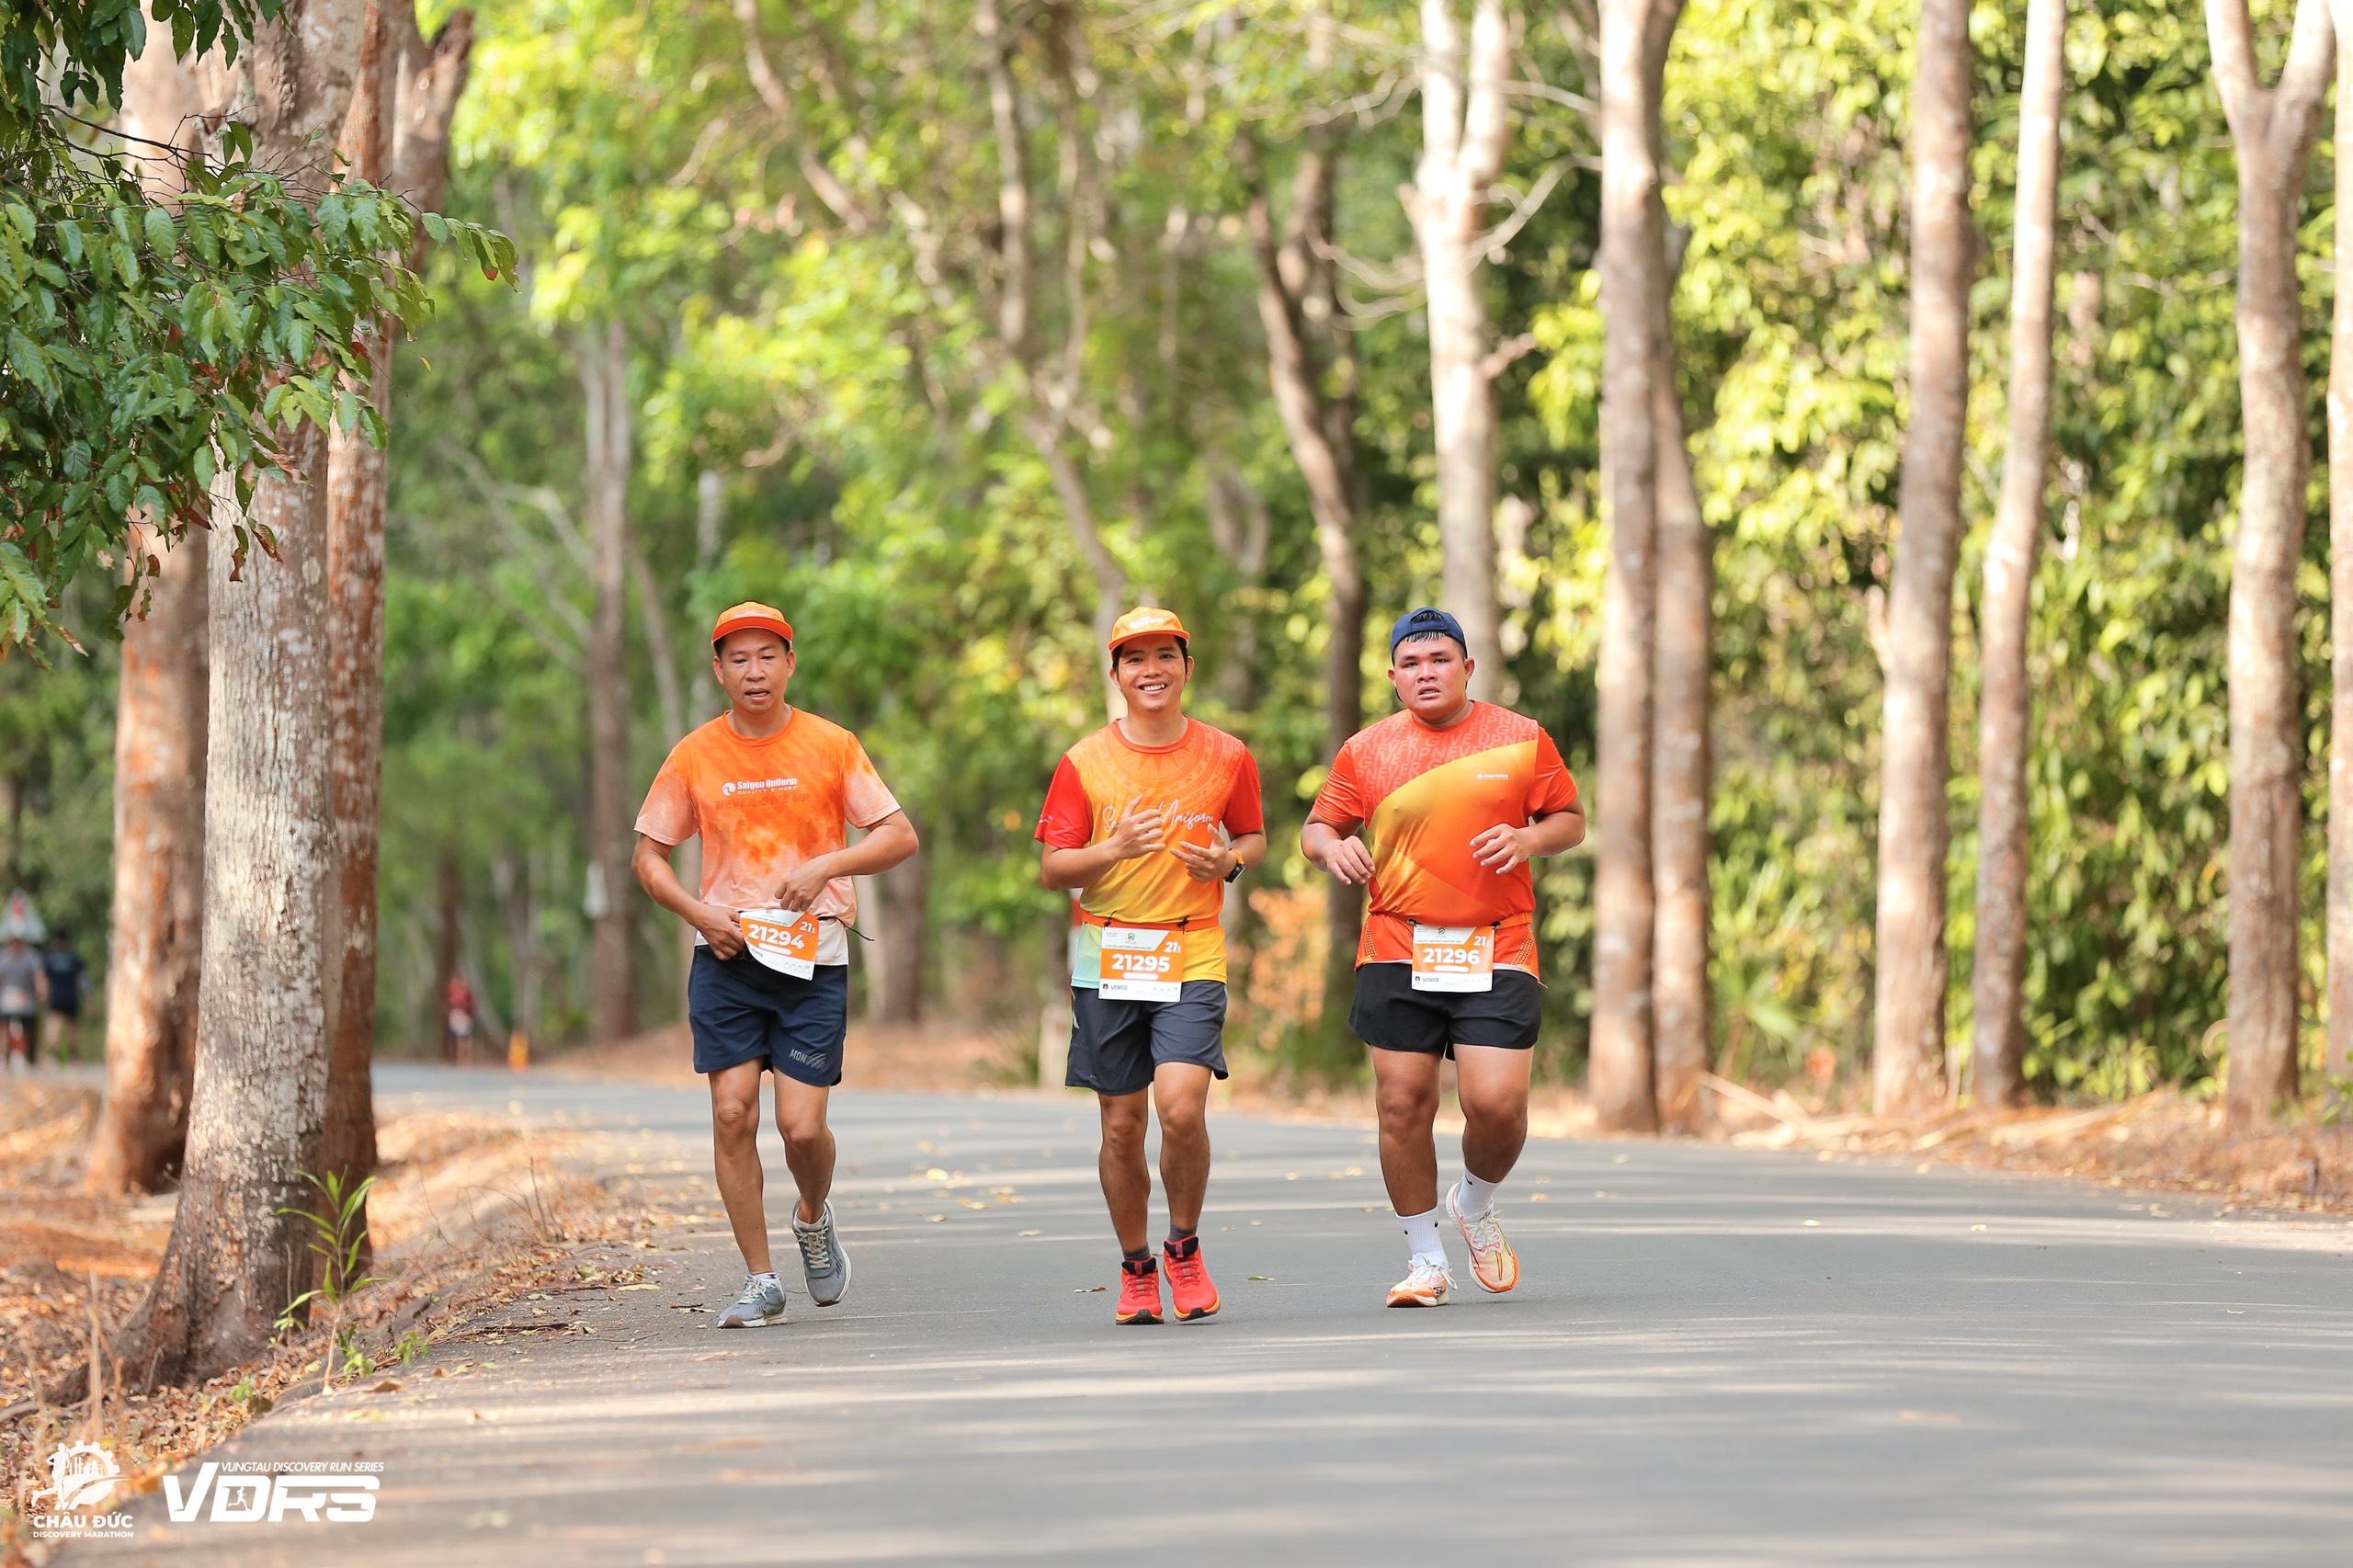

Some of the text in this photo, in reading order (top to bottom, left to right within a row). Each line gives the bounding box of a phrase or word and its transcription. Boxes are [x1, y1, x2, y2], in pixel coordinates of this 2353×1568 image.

[1426, 733, 1472, 747] GIVE
[1358, 753, 1401, 769] GIVE
[737, 778, 797, 790] Saigon Uniform
[716, 798, 756, 810] NEVER
[793, 793, 811, 802] UP
[747, 924, 805, 949] 21294
[1111, 953, 1171, 972] 21295
[1423, 948, 1481, 965] 21296
